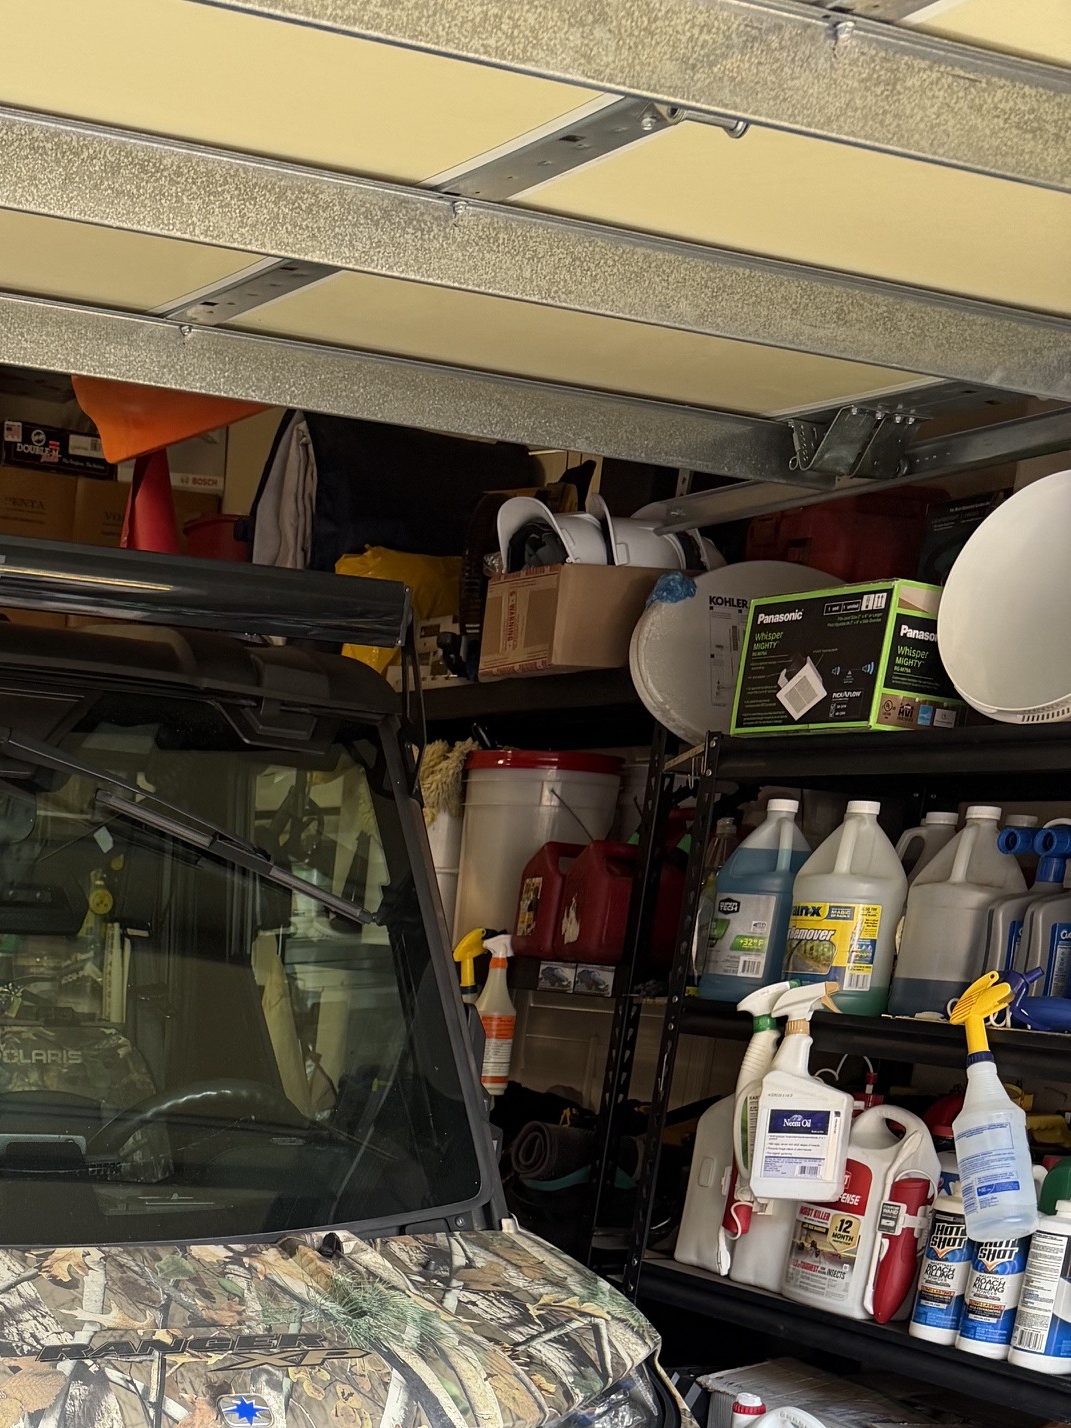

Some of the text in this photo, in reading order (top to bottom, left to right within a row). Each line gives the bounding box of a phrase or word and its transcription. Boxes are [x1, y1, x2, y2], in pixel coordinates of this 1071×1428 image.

[192, 476, 218, 487] BOSCH
[709, 595, 749, 609] KOHLER
[757, 609, 804, 625] Panasonic
[755, 630, 784, 642] Whisper
[753, 641, 778, 651] MIGHTY
[897, 645, 929, 659] Whisper
[895, 656, 923, 668] MIGHTY
[783, 1118, 811, 1128] Neem Oil
[814, 1209, 831, 1221] KILLER
[837, 1218, 853, 1234] 12
[936, 1223, 966, 1236] HOT
[831, 1232, 854, 1242] MONTH
[930, 1235, 968, 1250] SHOT
[978, 1247, 1019, 1262] SHOT
[827, 1268, 846, 1280] INSECTS
[927, 1264, 955, 1275] ROACH
[925, 1271, 955, 1281] KILLING
[975, 1277, 1006, 1287] ROACH
[973, 1284, 1005, 1294] KILLING
[35, 1333, 328, 1363] RANGER
[208, 1347, 371, 1373] XP
